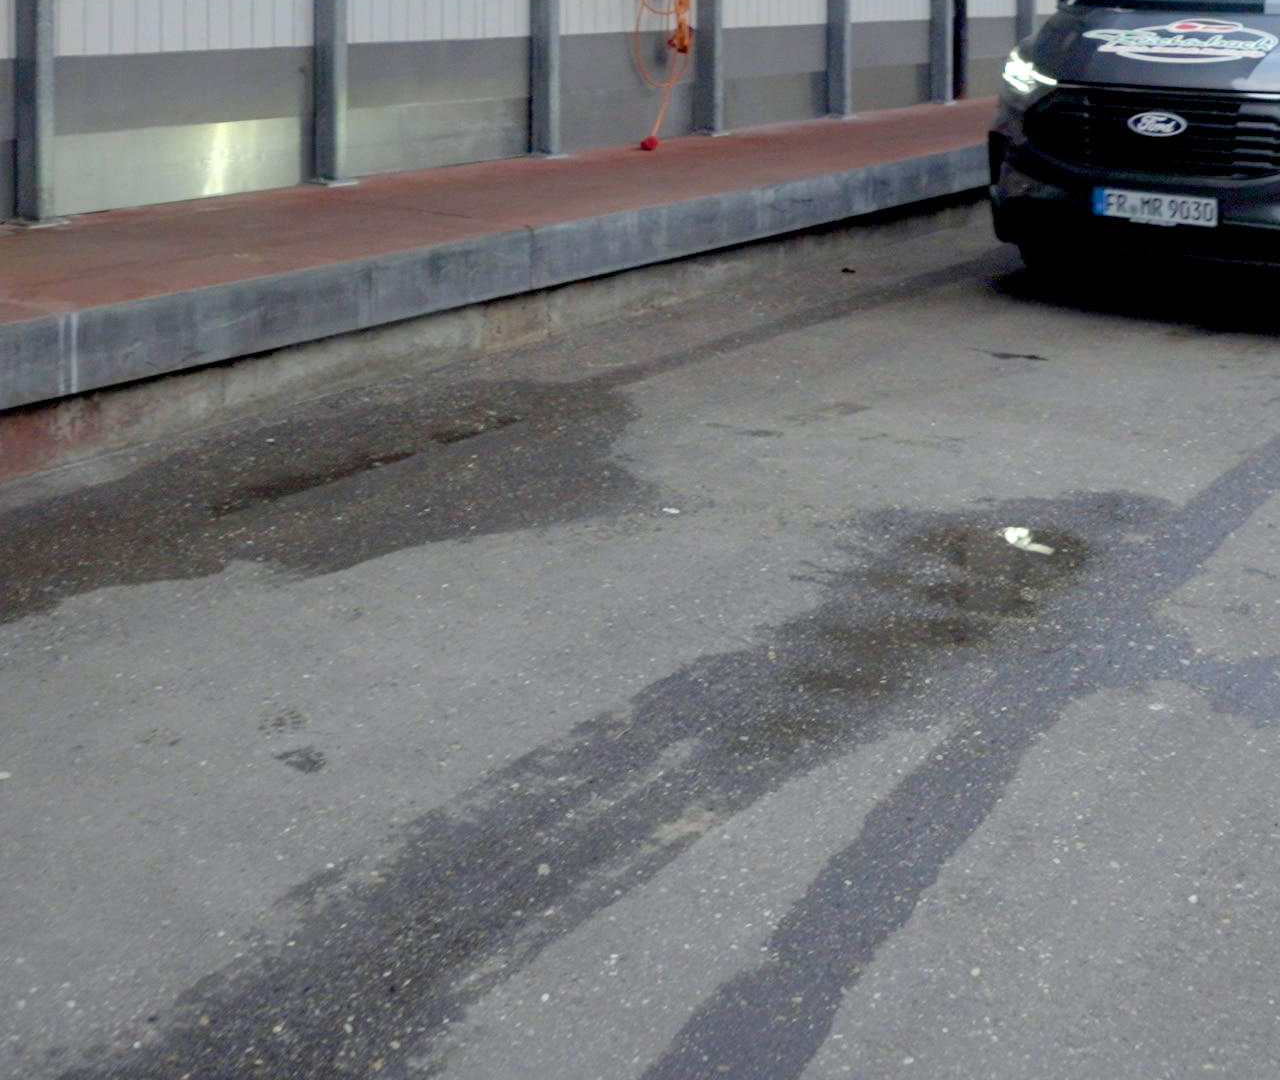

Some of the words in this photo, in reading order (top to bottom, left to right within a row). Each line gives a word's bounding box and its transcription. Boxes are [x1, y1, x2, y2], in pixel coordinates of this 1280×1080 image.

[1136, 115, 1176, 134] Ford
[1106, 193, 1128, 212] FR
[1140, 196, 1163, 217] MR
[1168, 199, 1214, 222] 9030
